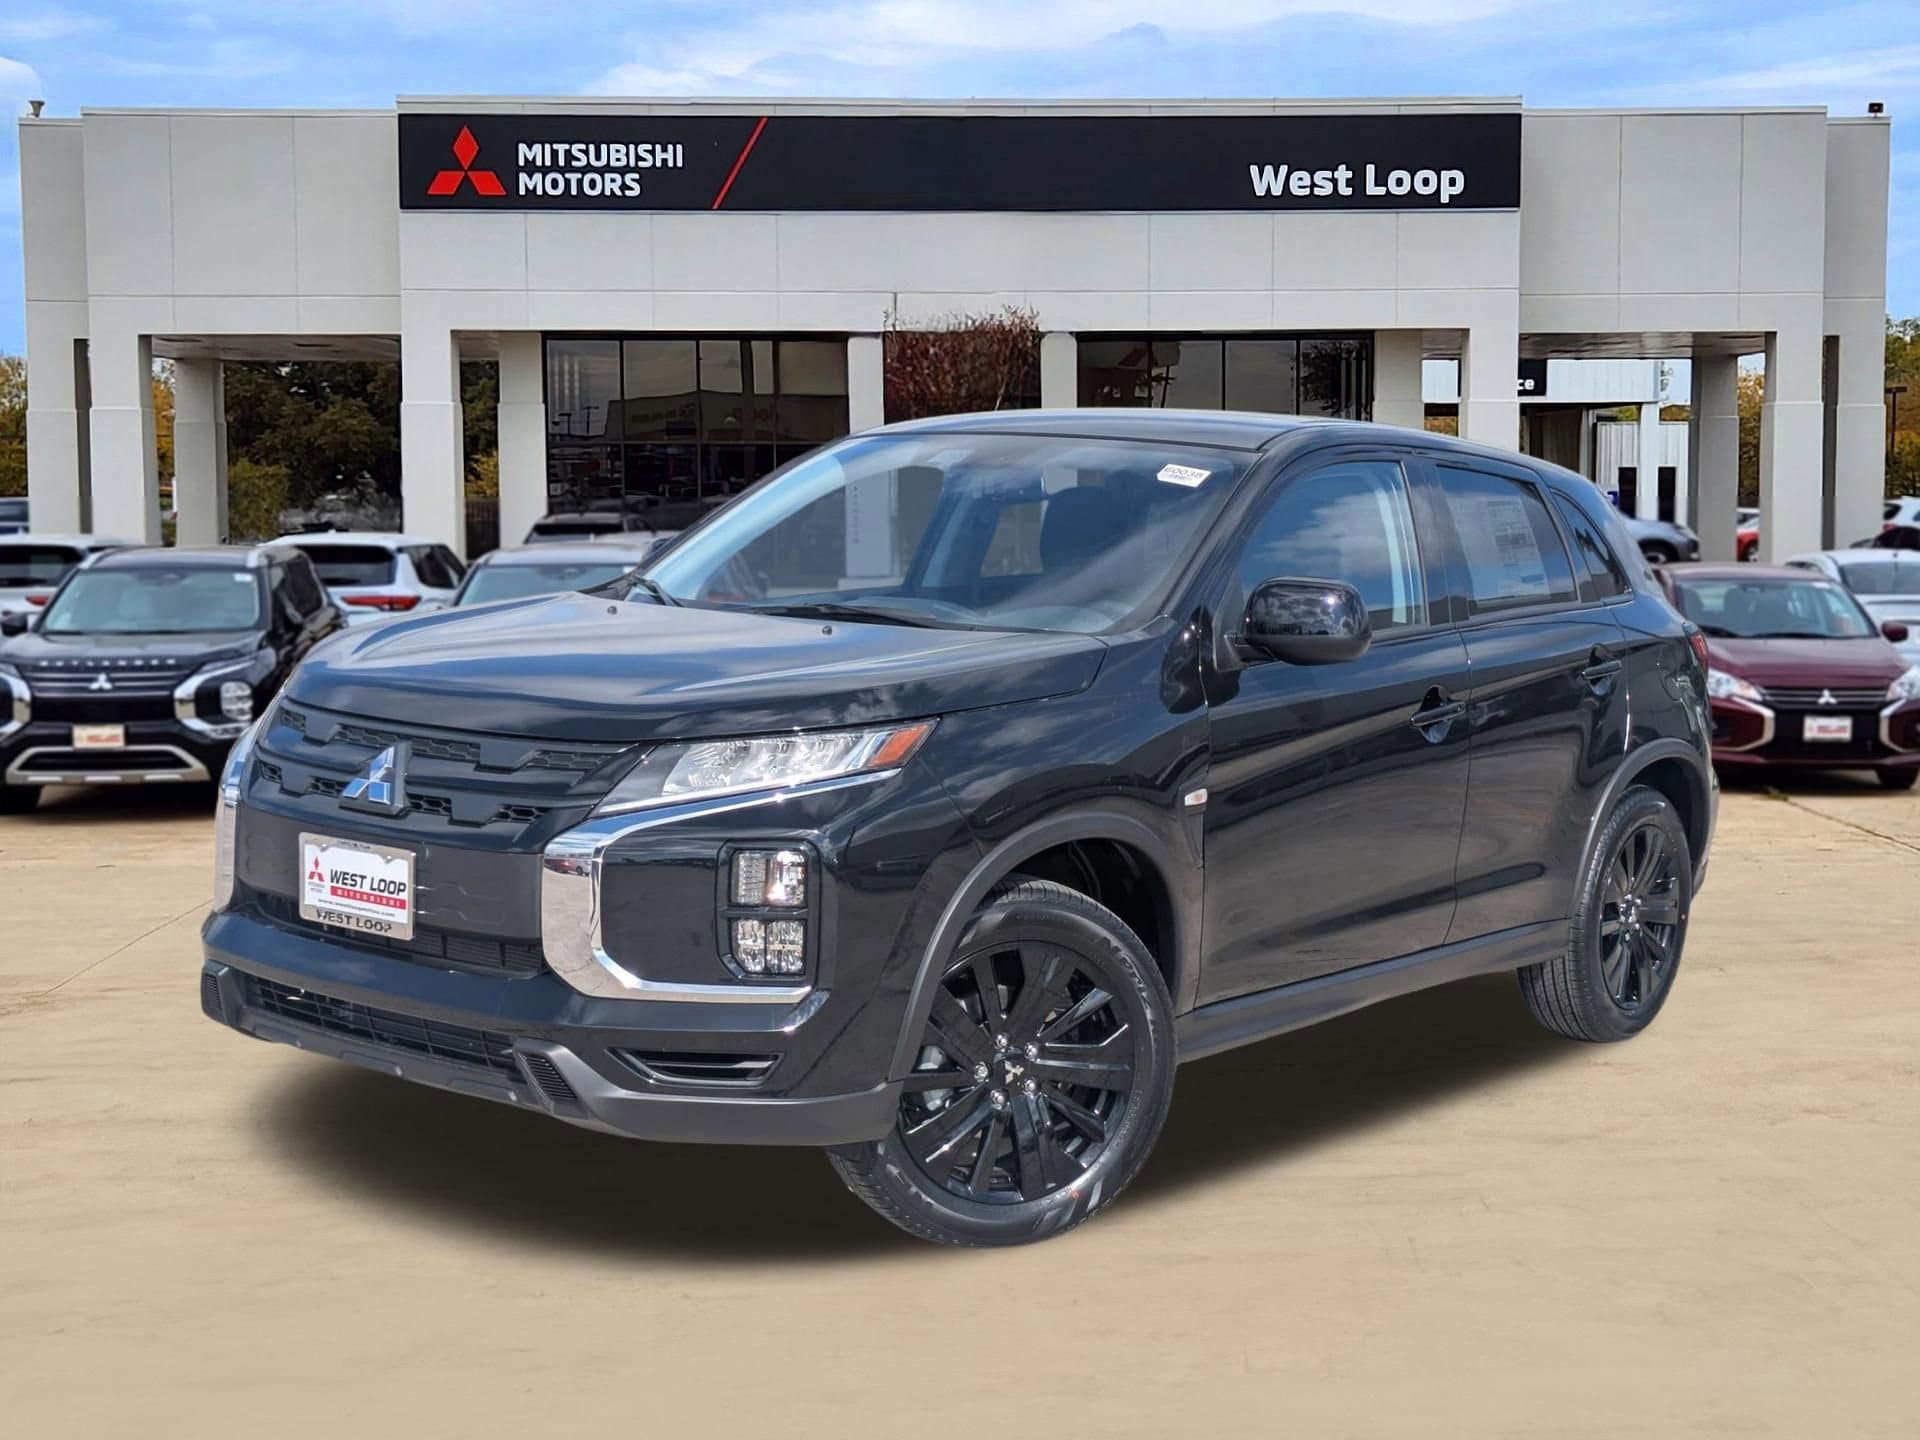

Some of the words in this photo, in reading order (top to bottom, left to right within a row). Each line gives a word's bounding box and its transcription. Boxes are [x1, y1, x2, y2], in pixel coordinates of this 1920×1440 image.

[517, 142, 683, 168] MITSUBISHI
[518, 172, 641, 197] MOTORS
[1249, 164, 1353, 196] West
[1365, 164, 1465, 203] Loop
[330, 868, 367, 888] WEST
[369, 877, 407, 897] LOOP
[316, 909, 353, 925] WEST
[356, 917, 393, 933] LOOP
